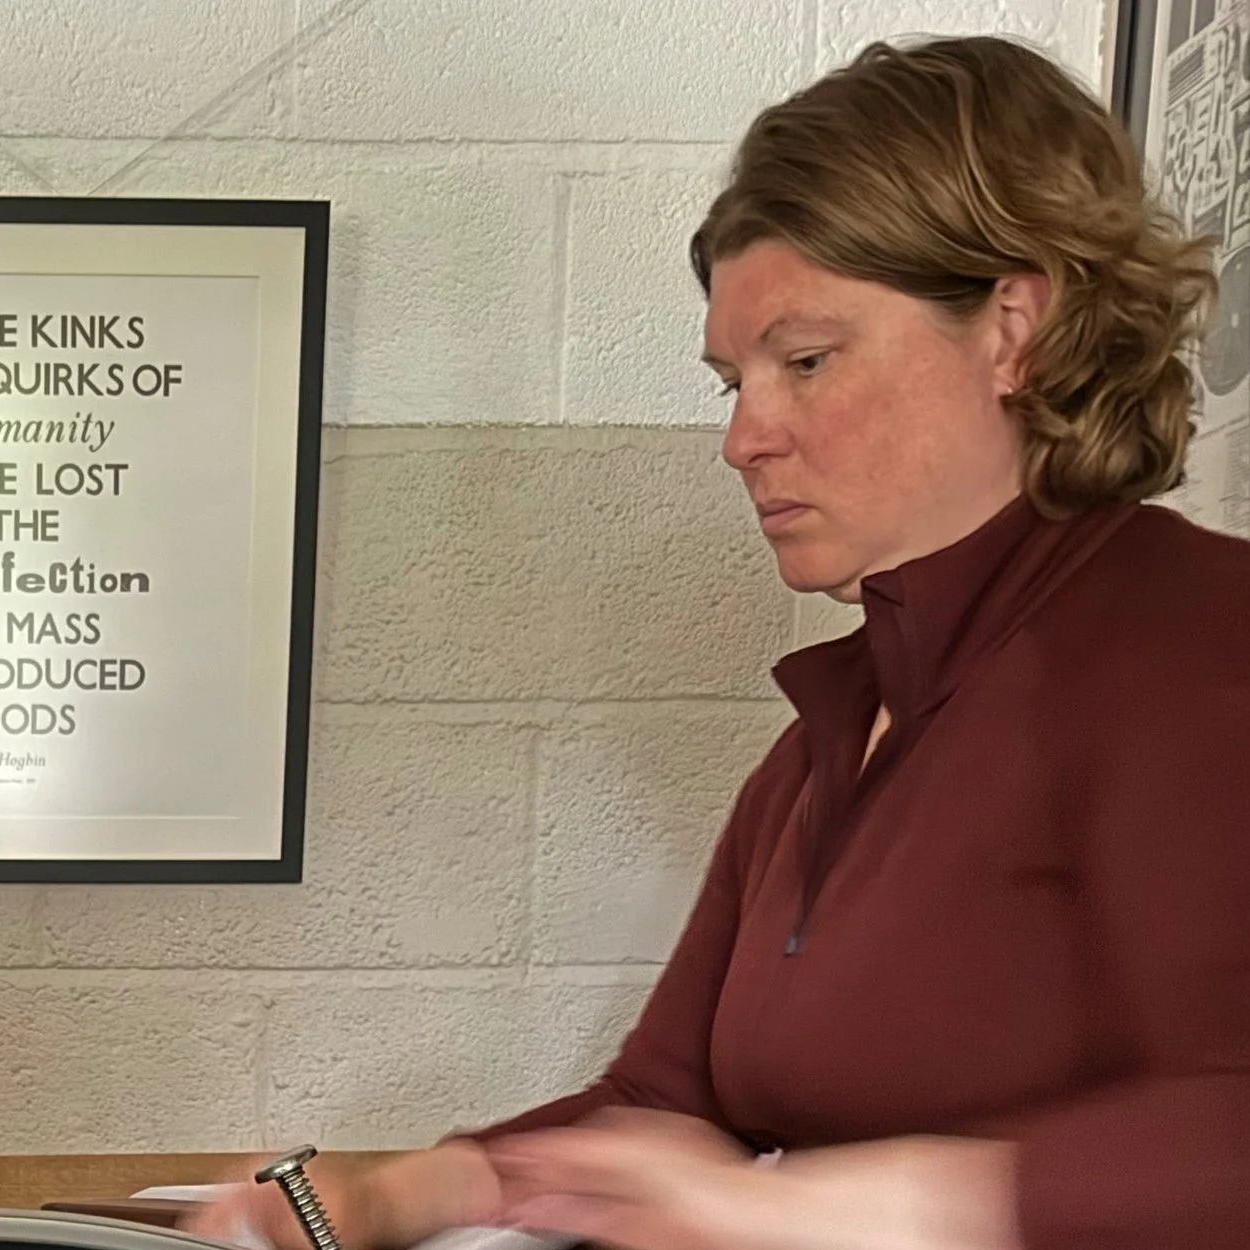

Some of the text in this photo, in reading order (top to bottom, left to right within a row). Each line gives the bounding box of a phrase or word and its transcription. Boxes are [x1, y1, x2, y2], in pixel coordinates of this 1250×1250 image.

[31, 314, 145, 349] KINKS
[132, 364, 183, 397] OF
[36, 463, 129, 496] LOST
[6, 612, 101, 645] MASS
